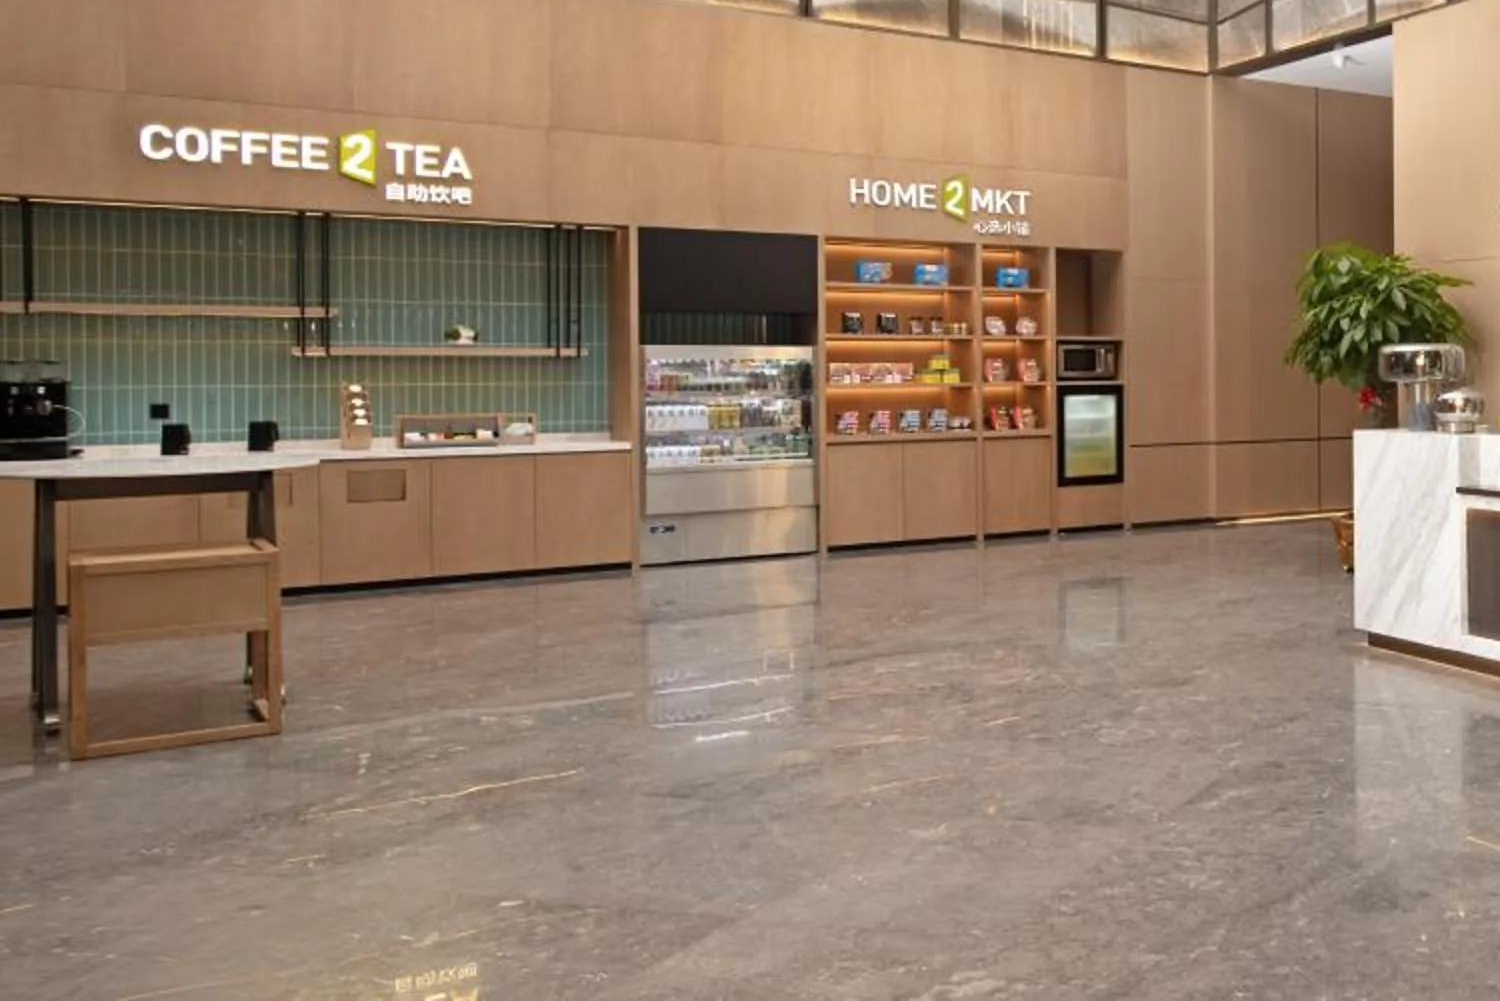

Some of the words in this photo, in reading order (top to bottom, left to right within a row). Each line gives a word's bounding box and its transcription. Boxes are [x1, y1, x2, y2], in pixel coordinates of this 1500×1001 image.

[140, 124, 329, 170] COFFEE
[343, 134, 372, 178] 2
[386, 142, 472, 179] TEA
[385, 183, 472, 204] 自助饮吧
[850, 178, 937, 209] HOME
[945, 180, 964, 215] 2
[971, 187, 1031, 215] MKT
